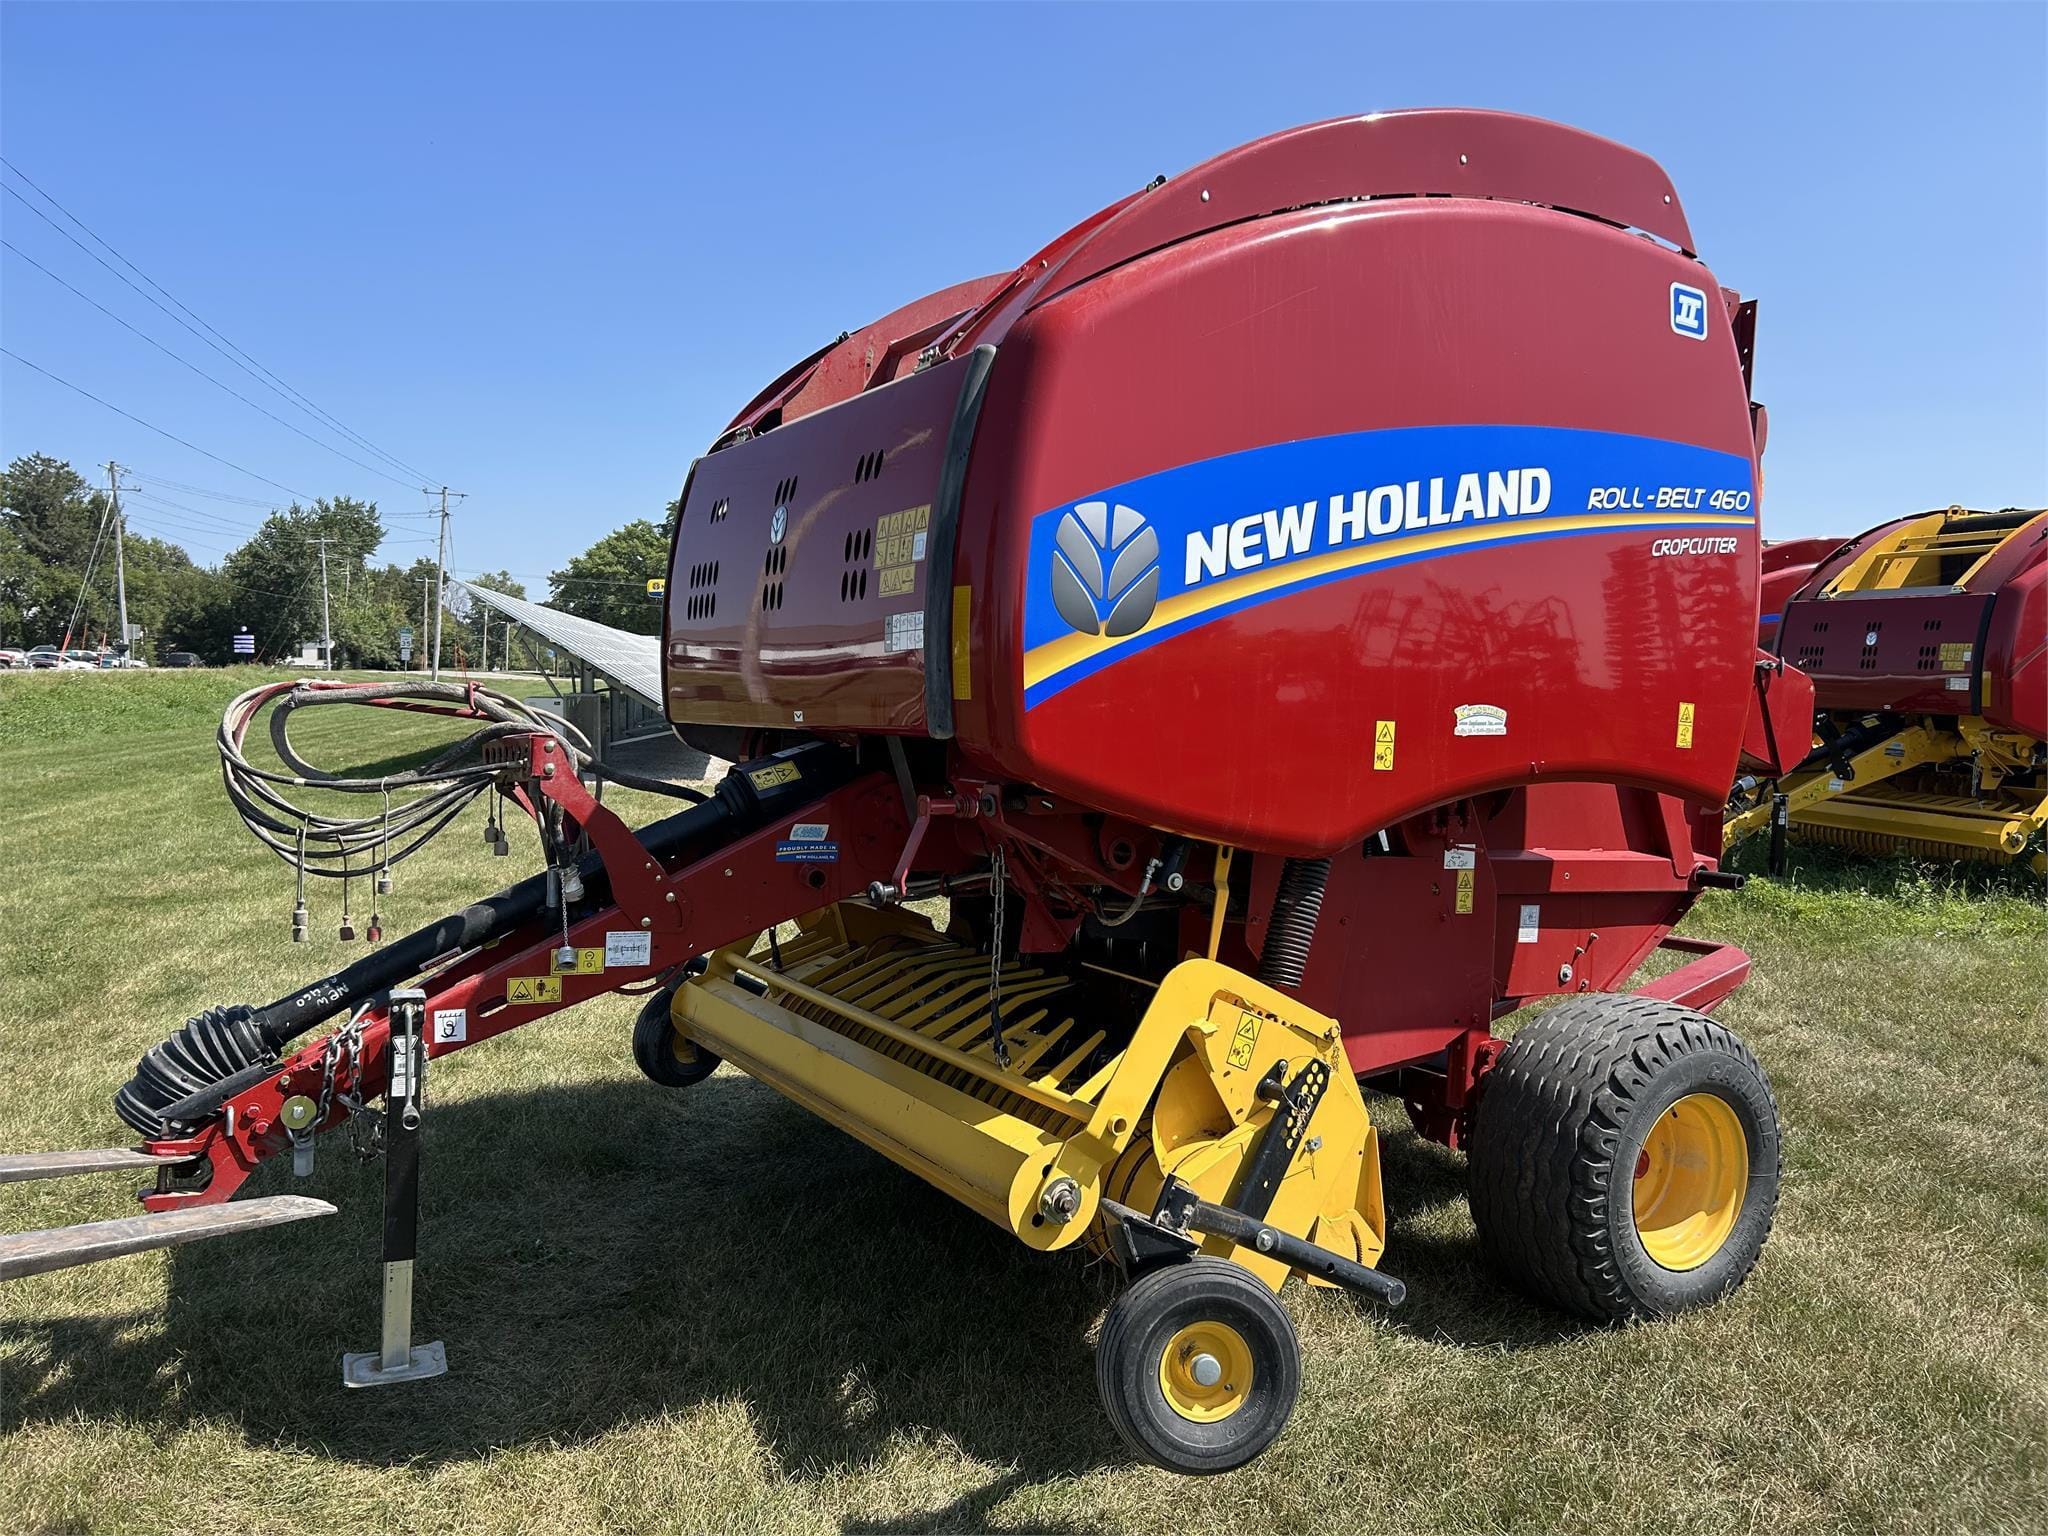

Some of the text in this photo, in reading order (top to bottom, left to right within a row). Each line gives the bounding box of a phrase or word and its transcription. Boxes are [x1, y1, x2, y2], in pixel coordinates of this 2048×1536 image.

[1185, 467, 1552, 585] NEW HOLLAND
[1587, 486, 1751, 511] ROLL-BELT 460
[1651, 537, 1738, 557] CROPCUTTER
[1706, 1062, 1774, 1149] CARLISLE
